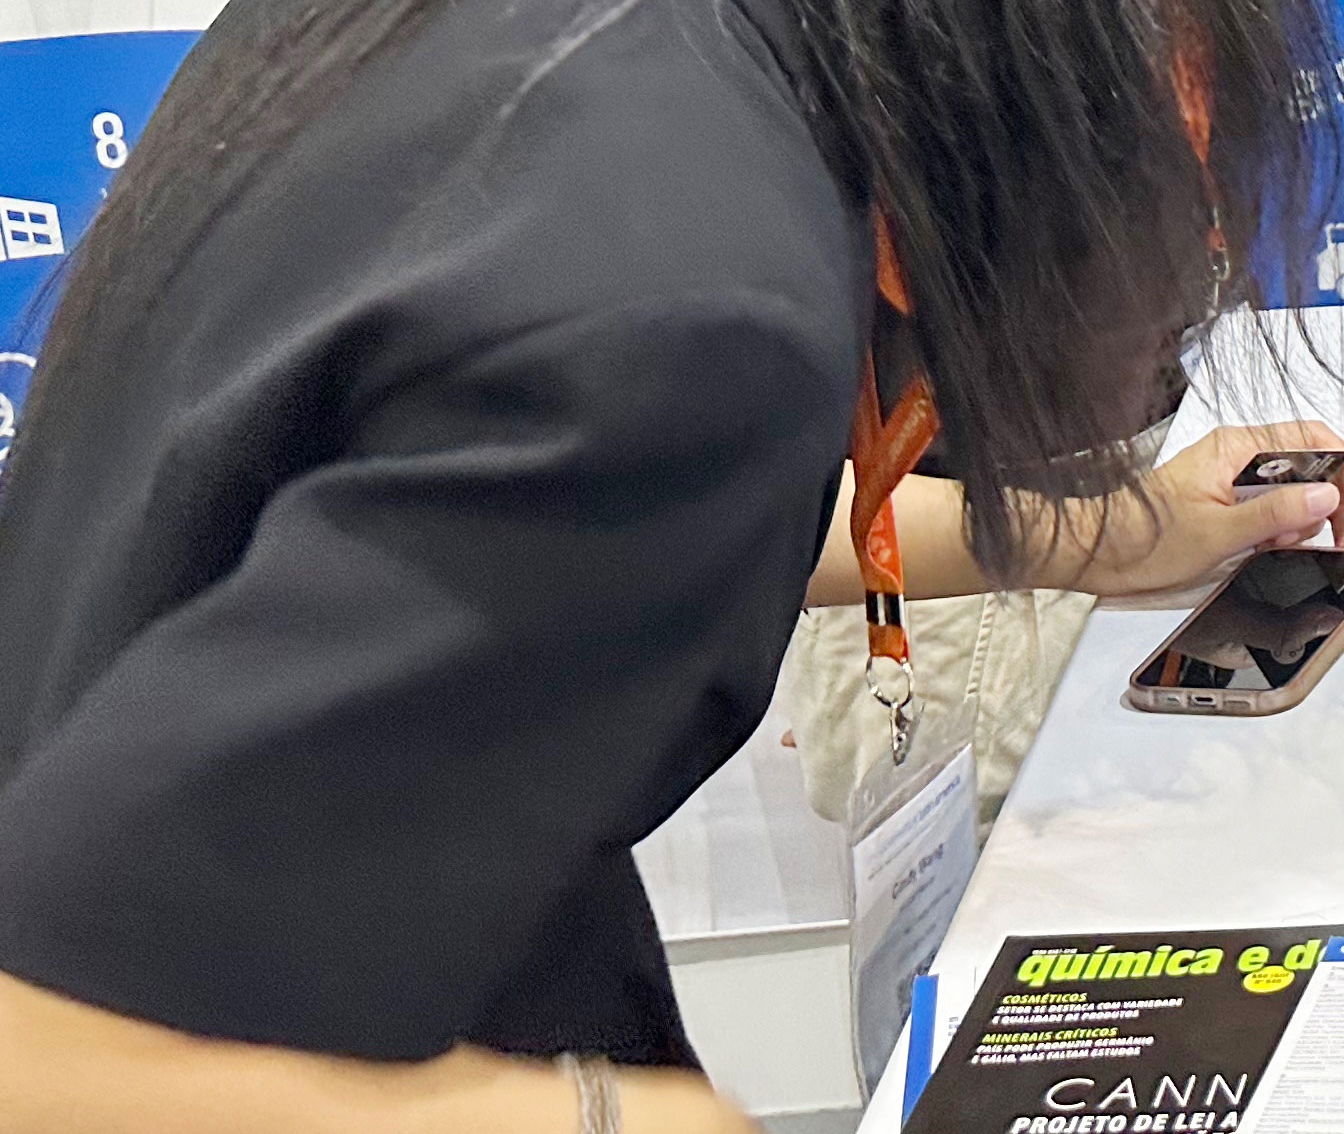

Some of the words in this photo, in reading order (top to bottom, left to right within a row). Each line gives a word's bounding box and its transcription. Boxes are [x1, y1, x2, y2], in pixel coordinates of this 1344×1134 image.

[1016, 945, 1224, 987] química
[1002, 992, 1088, 1005] COSMÉTICOS
[982, 1030, 1052, 1044] MINERAIS
[1055, 1027, 1118, 1040] CRÍTICOS
[1046, 1073, 1248, 1111] CANN
[1011, 1115, 1127, 1134] PROJETO
[1133, 1114, 1169, 1131] DE
[1174, 1112, 1215, 1130] LEI
